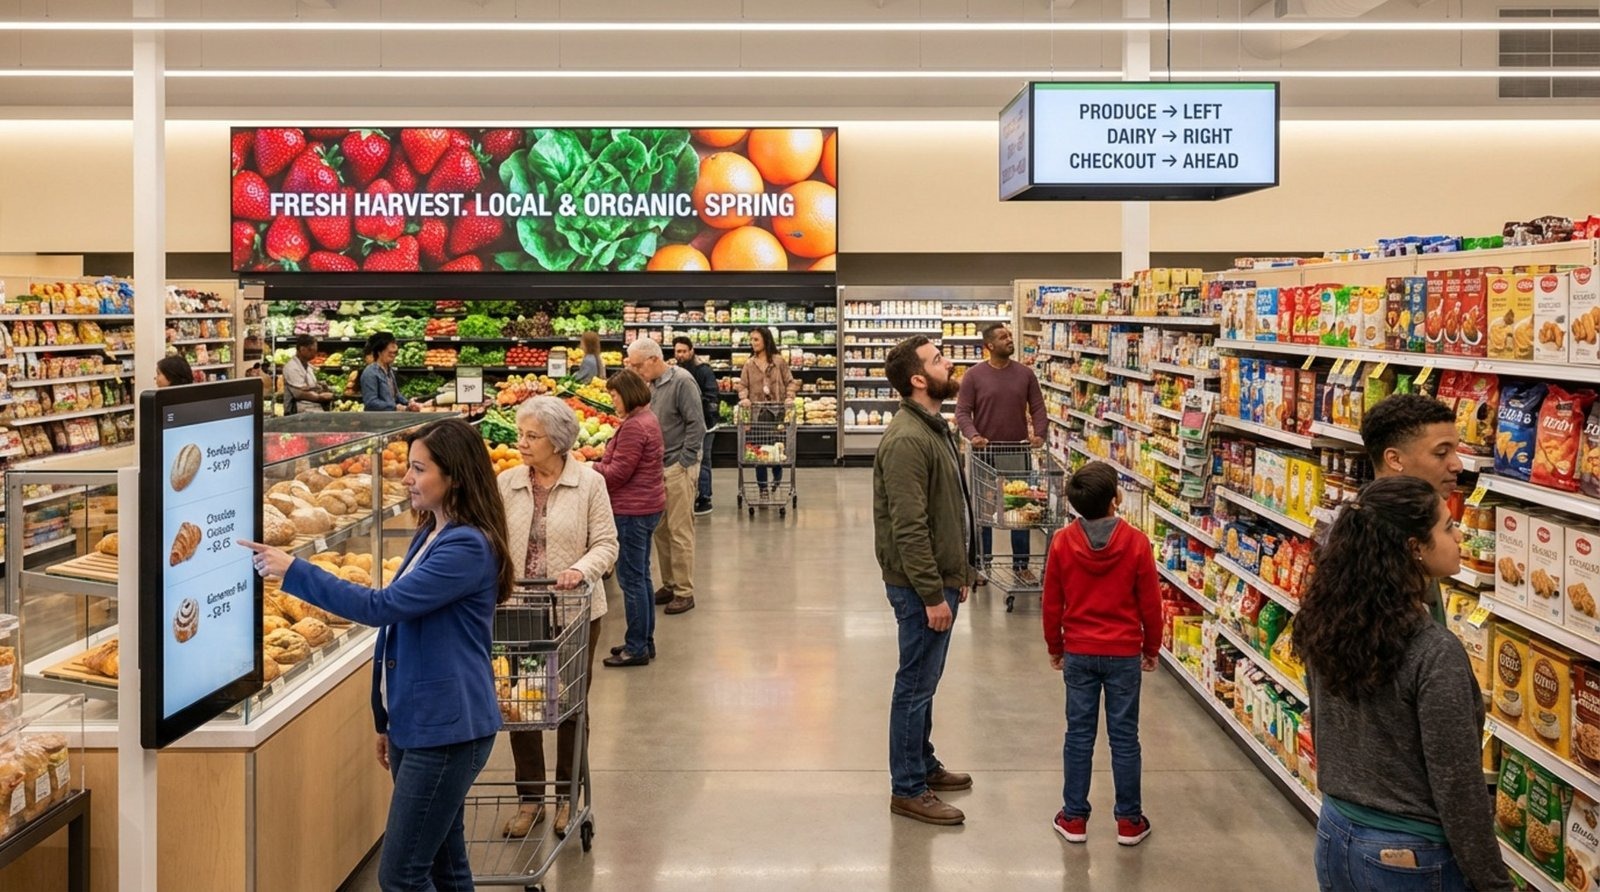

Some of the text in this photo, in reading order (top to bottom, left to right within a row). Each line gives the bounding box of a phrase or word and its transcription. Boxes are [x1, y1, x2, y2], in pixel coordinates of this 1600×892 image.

[1079, 103, 1223, 120] PRODUCE LEFT
[1107, 127, 1233, 145] DAIRY RIGHT
[1069, 152, 1239, 169] CHECKOUT AHEAD
[270, 192, 795, 217] FRESH HARVEST. LOCAL & ORGANIC. SPRING
